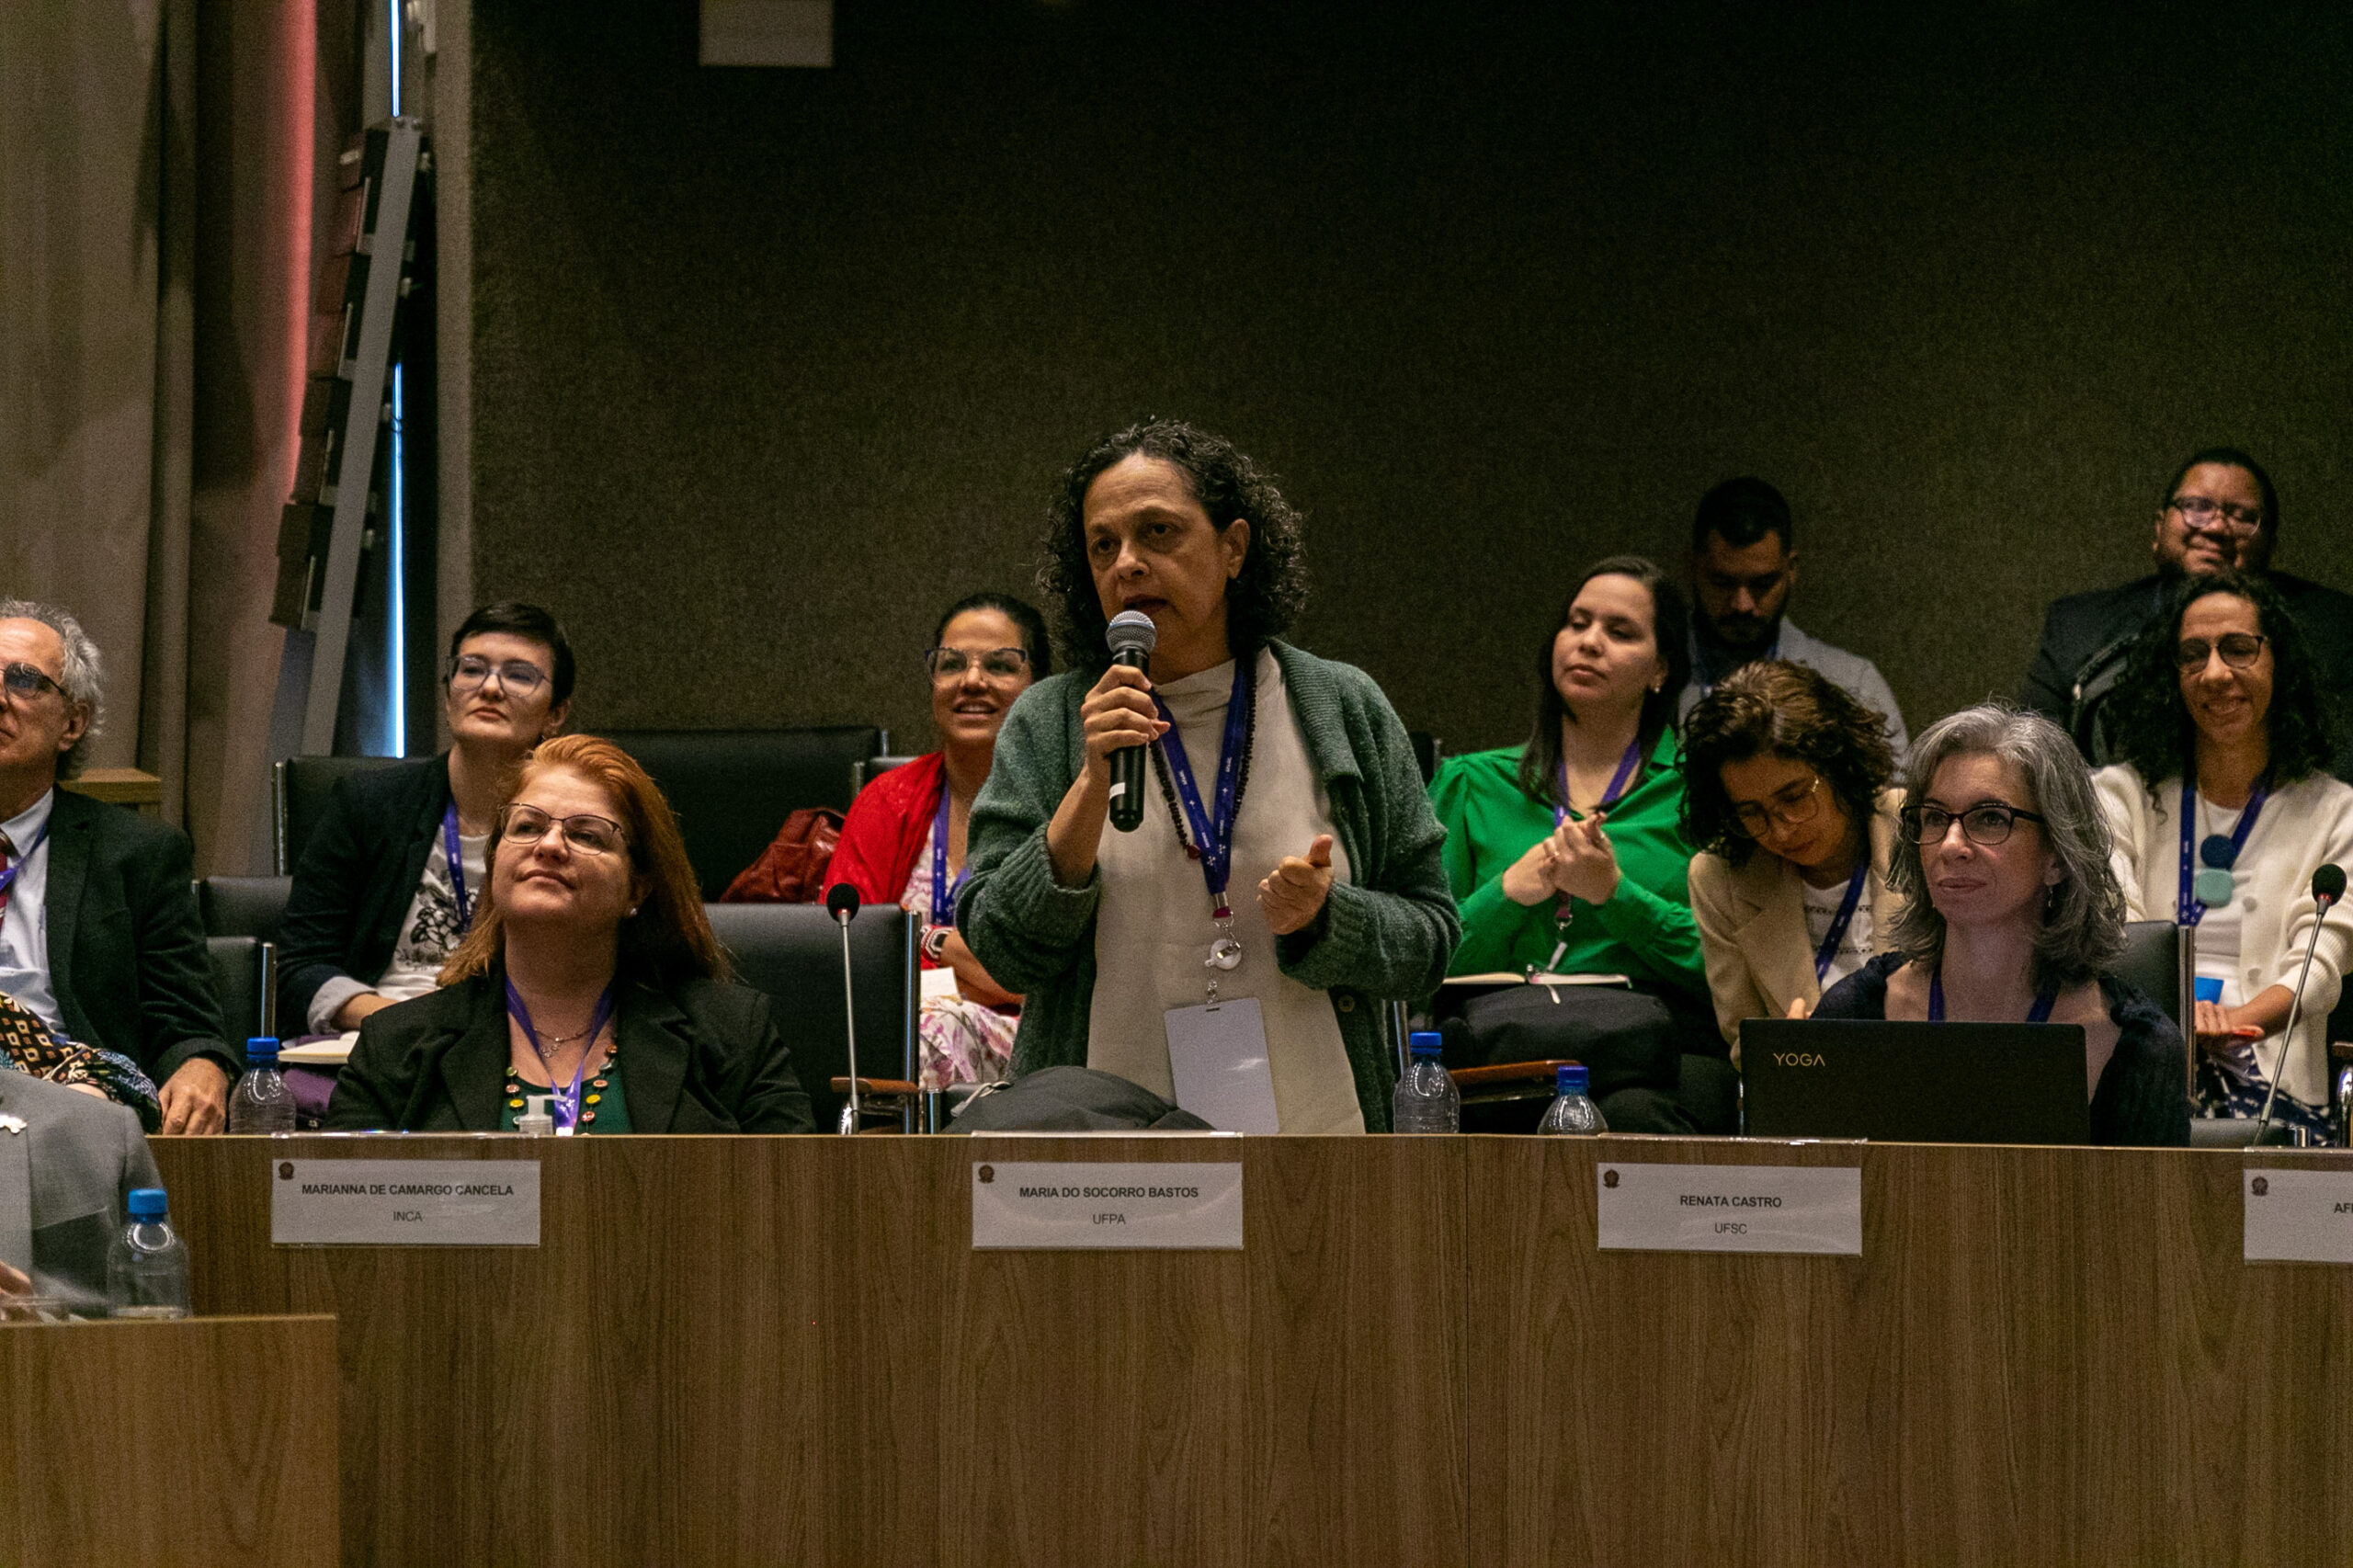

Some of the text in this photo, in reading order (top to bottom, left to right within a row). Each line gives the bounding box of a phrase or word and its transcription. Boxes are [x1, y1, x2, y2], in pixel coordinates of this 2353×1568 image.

[1772, 1052, 1826, 1067] YOGA
[301, 1184, 514, 1196] MARIANNA DE CAMARGO CANCELA
[1018, 1187, 1199, 1199] MARIA DO SOCORRO BASTOS
[1679, 1195, 1782, 1209] RENATA CASTRO
[2334, 1202, 2353, 1214] AF
[392, 1210, 423, 1222] INCA
[1092, 1213, 1126, 1225] UFPA
[1714, 1222, 1747, 1235] UFSC
